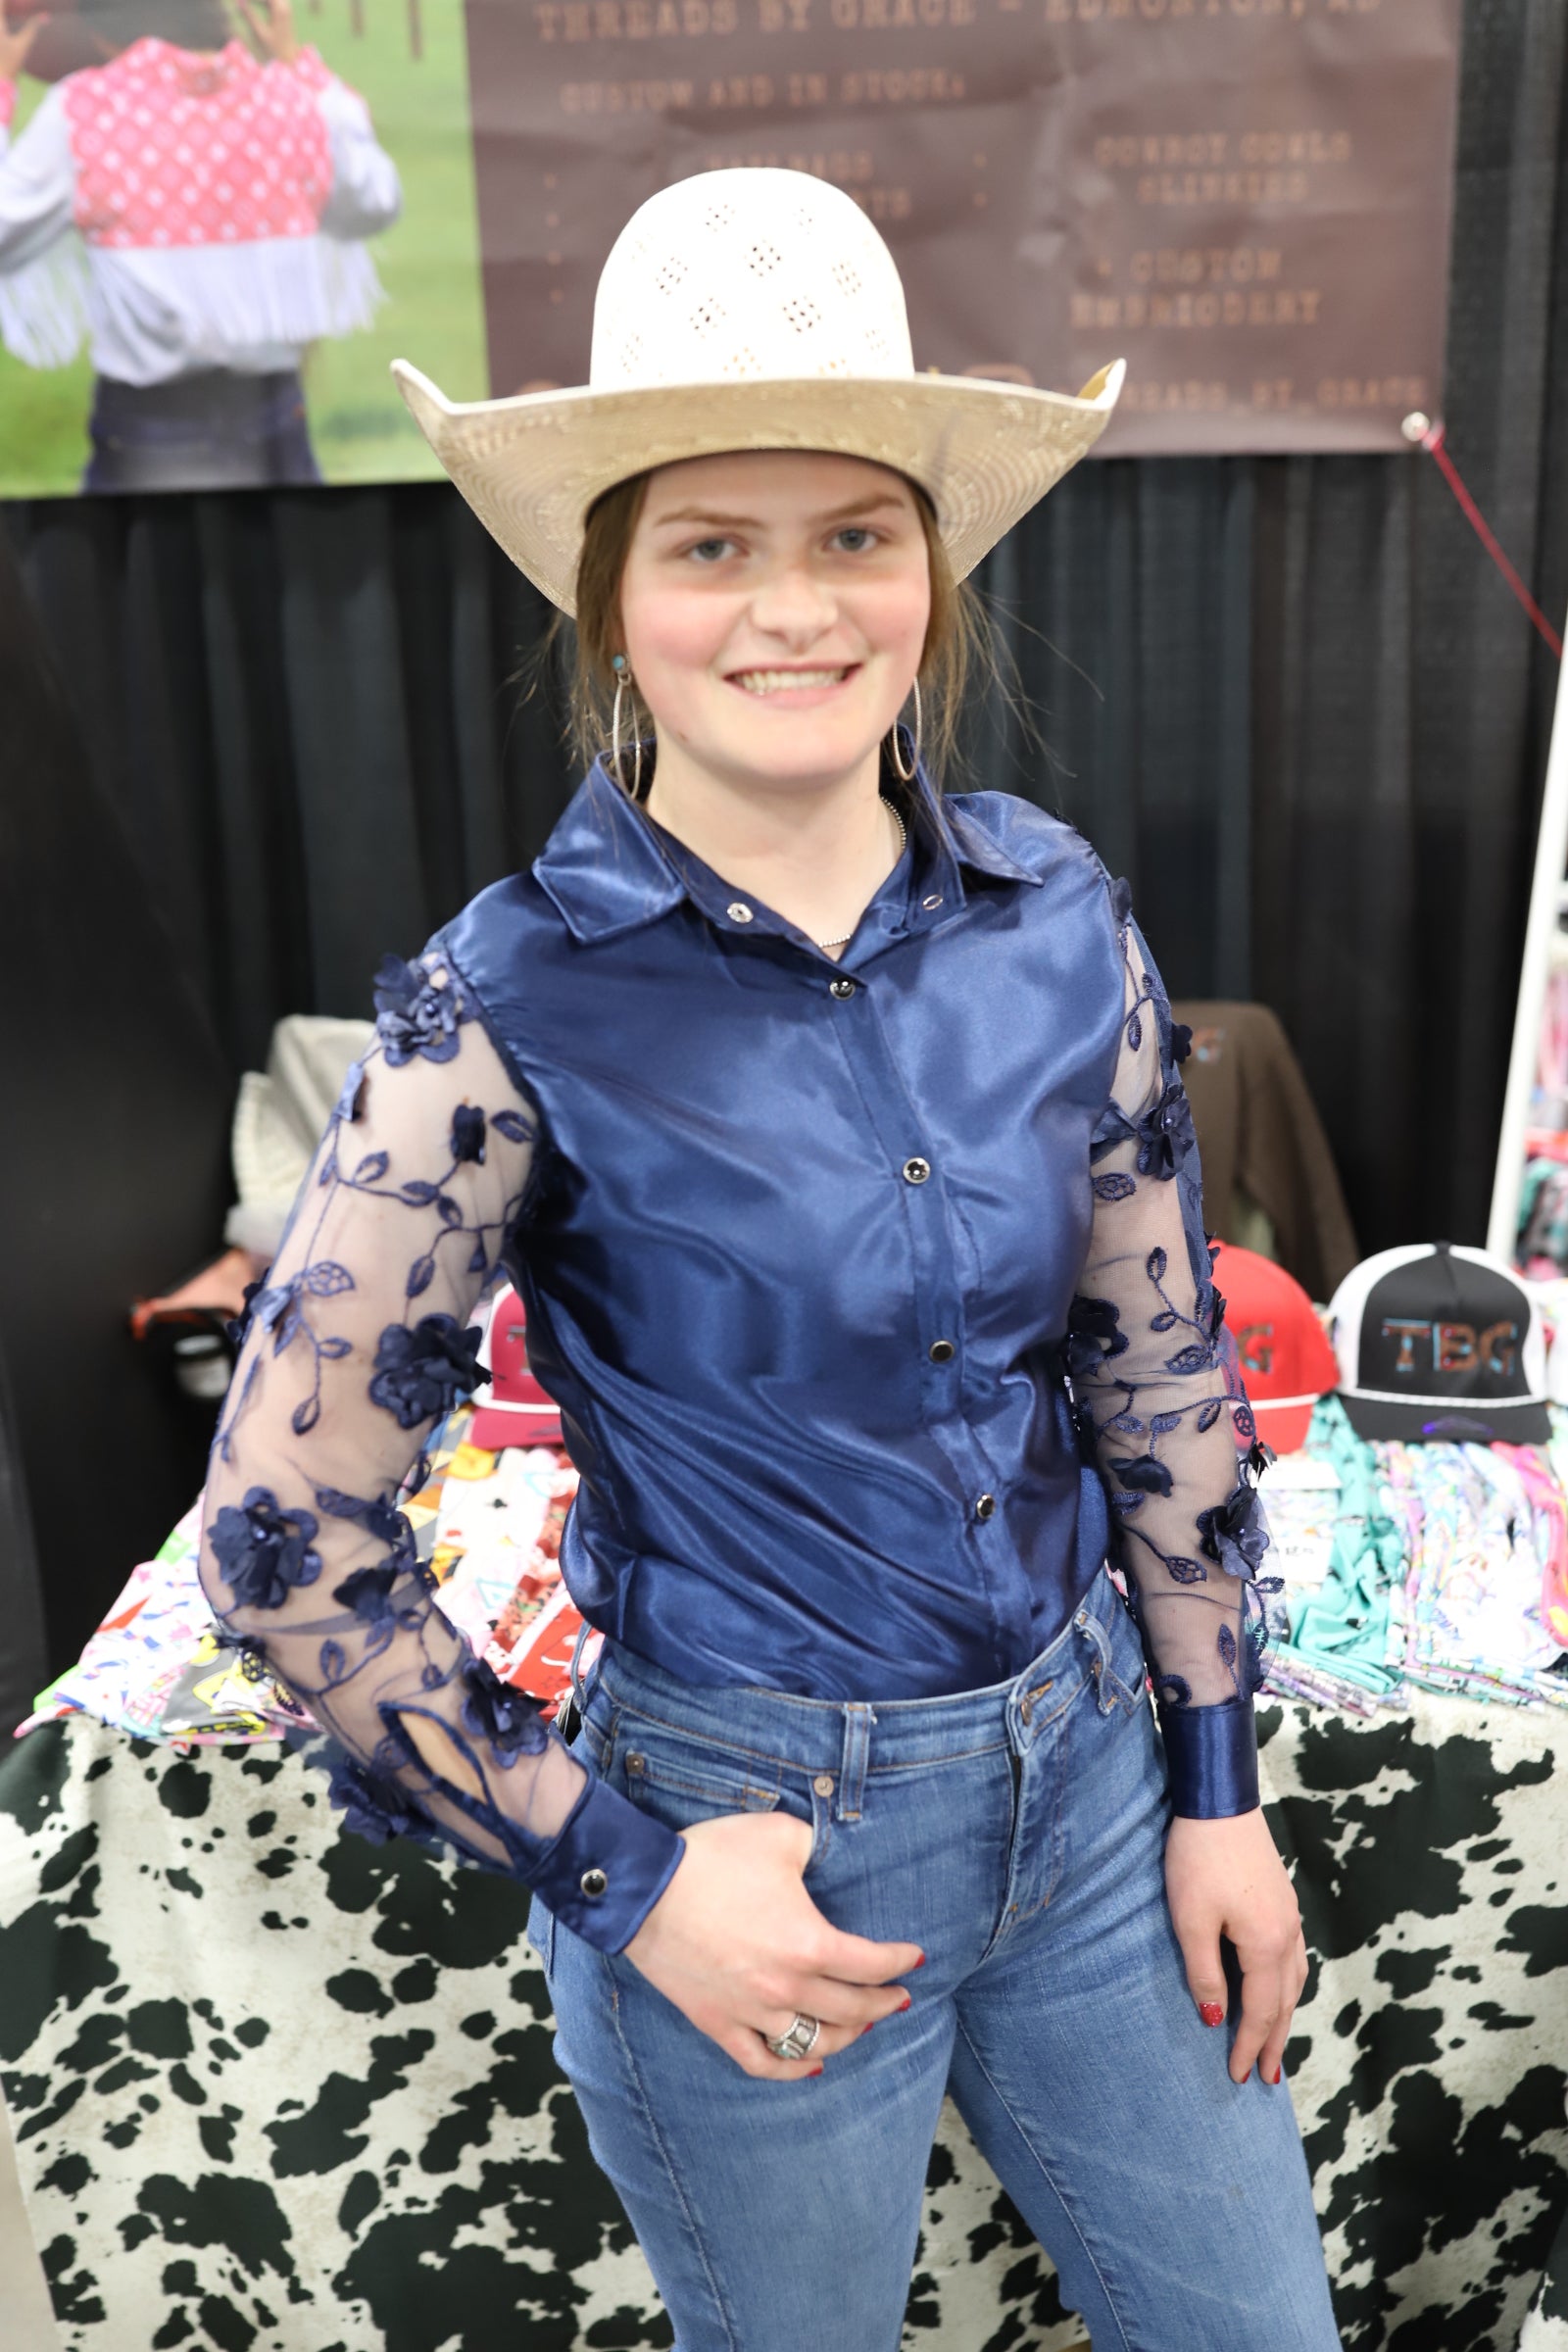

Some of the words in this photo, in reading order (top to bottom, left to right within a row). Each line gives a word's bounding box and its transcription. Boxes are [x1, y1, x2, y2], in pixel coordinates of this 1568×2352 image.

[534, 3, 738, 41] THREADS
[759, 0, 808, 31] BY
[831, 0, 975, 28] GRACE
[560, 80, 693, 114] CUSTOM
[709, 74, 774, 107] AND
[789, 73, 827, 105] IN
[1130, 248, 1282, 282] CUSTOM
[1381, 1317, 1518, 1376] TBG
